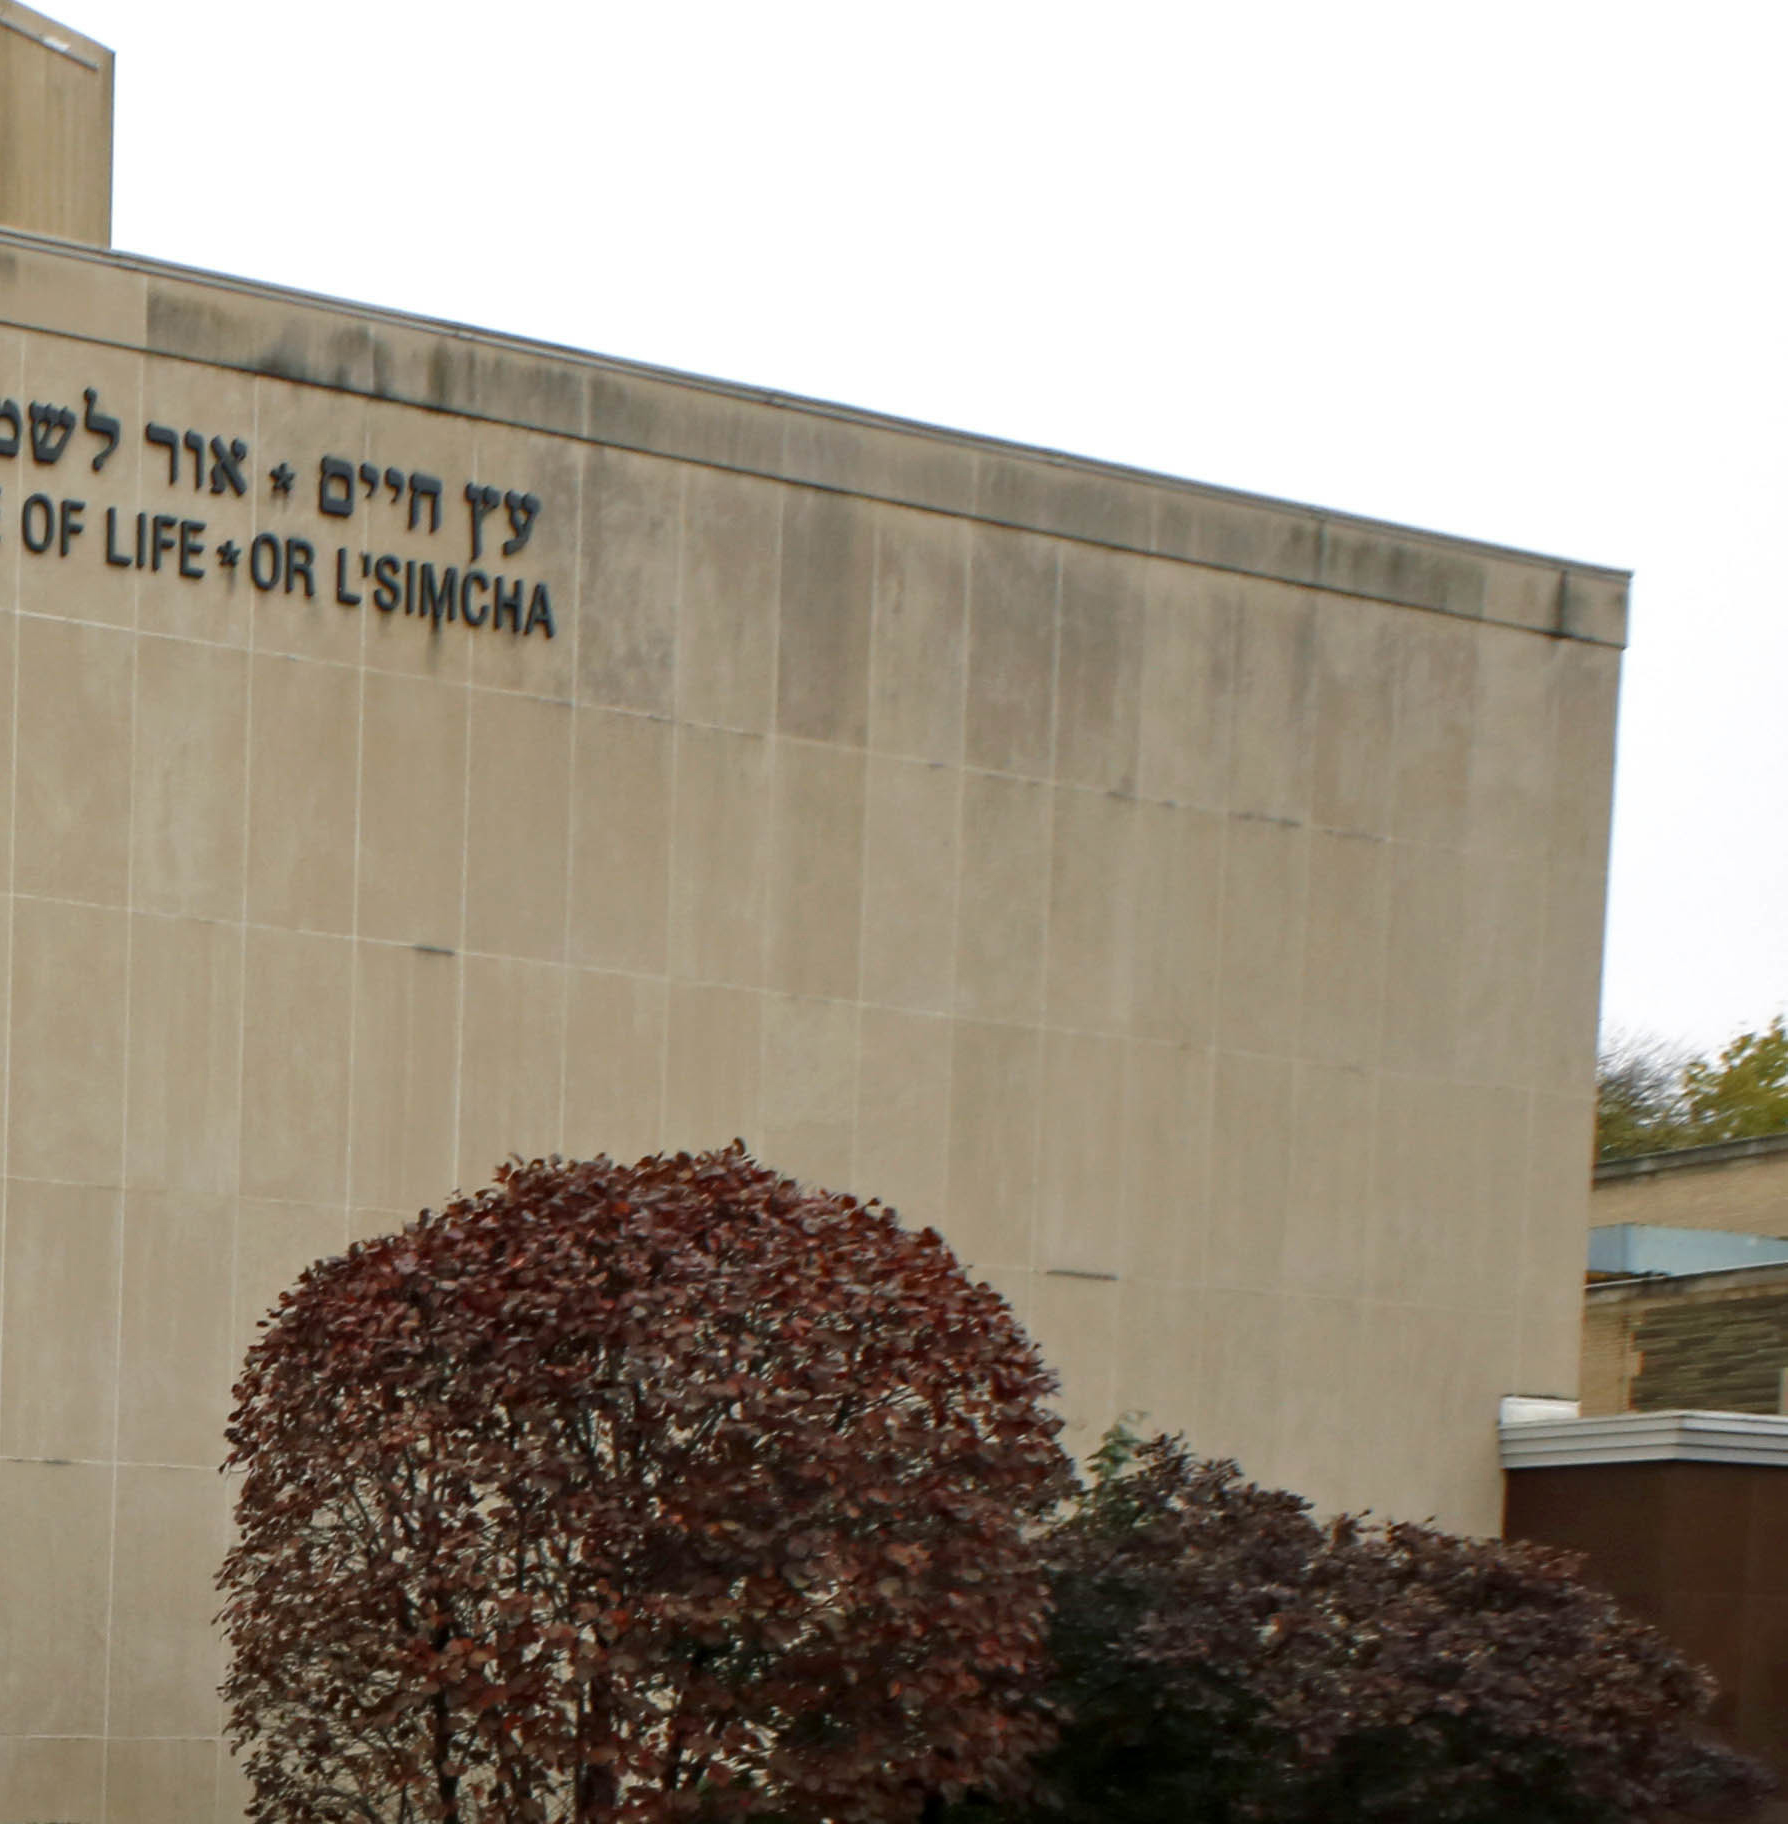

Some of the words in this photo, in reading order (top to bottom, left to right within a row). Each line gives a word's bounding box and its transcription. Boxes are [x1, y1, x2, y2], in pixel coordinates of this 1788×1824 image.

[144, 421, 249, 498] אור
[318, 454, 443, 534] חיים
[21, 493, 86, 558] OF
[106, 507, 206, 579] LIFE
[250, 532, 316, 599] OR
[336, 546, 557, 638] L'SIMCHA
